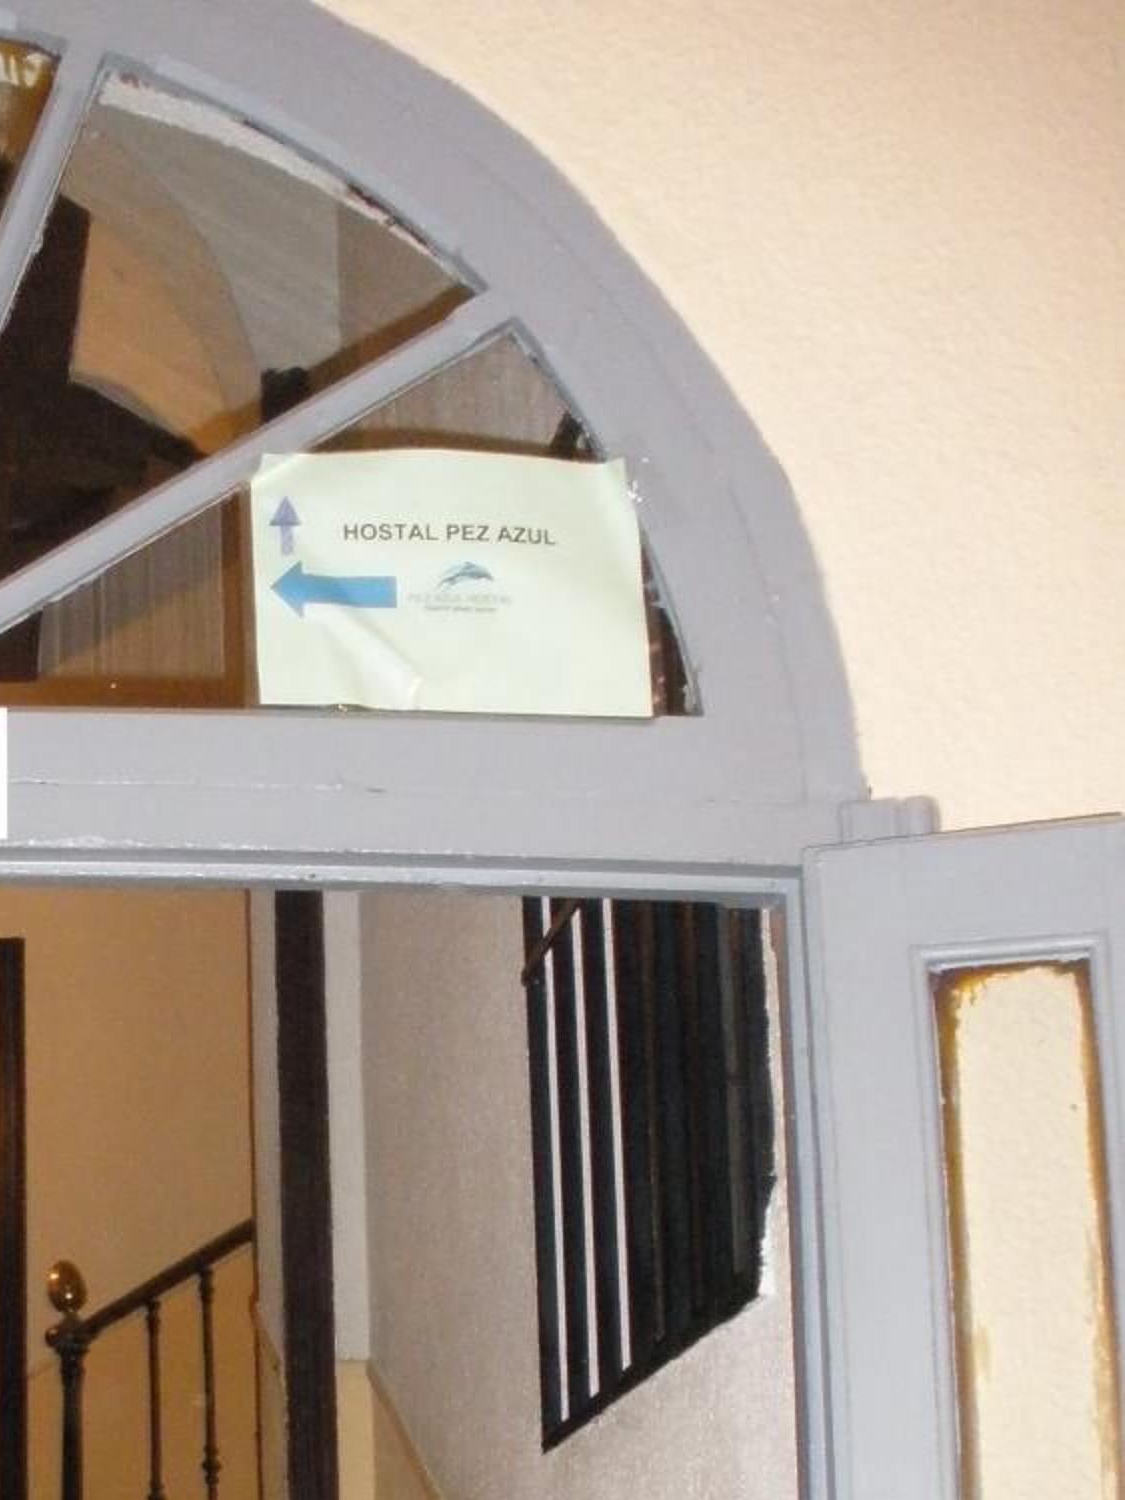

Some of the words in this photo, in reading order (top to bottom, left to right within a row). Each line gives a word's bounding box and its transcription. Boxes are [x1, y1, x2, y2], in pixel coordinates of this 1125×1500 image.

[342, 522, 438, 542] HOSTAL
[445, 523, 491, 543] PEZ
[496, 525, 556, 547] AZUL
